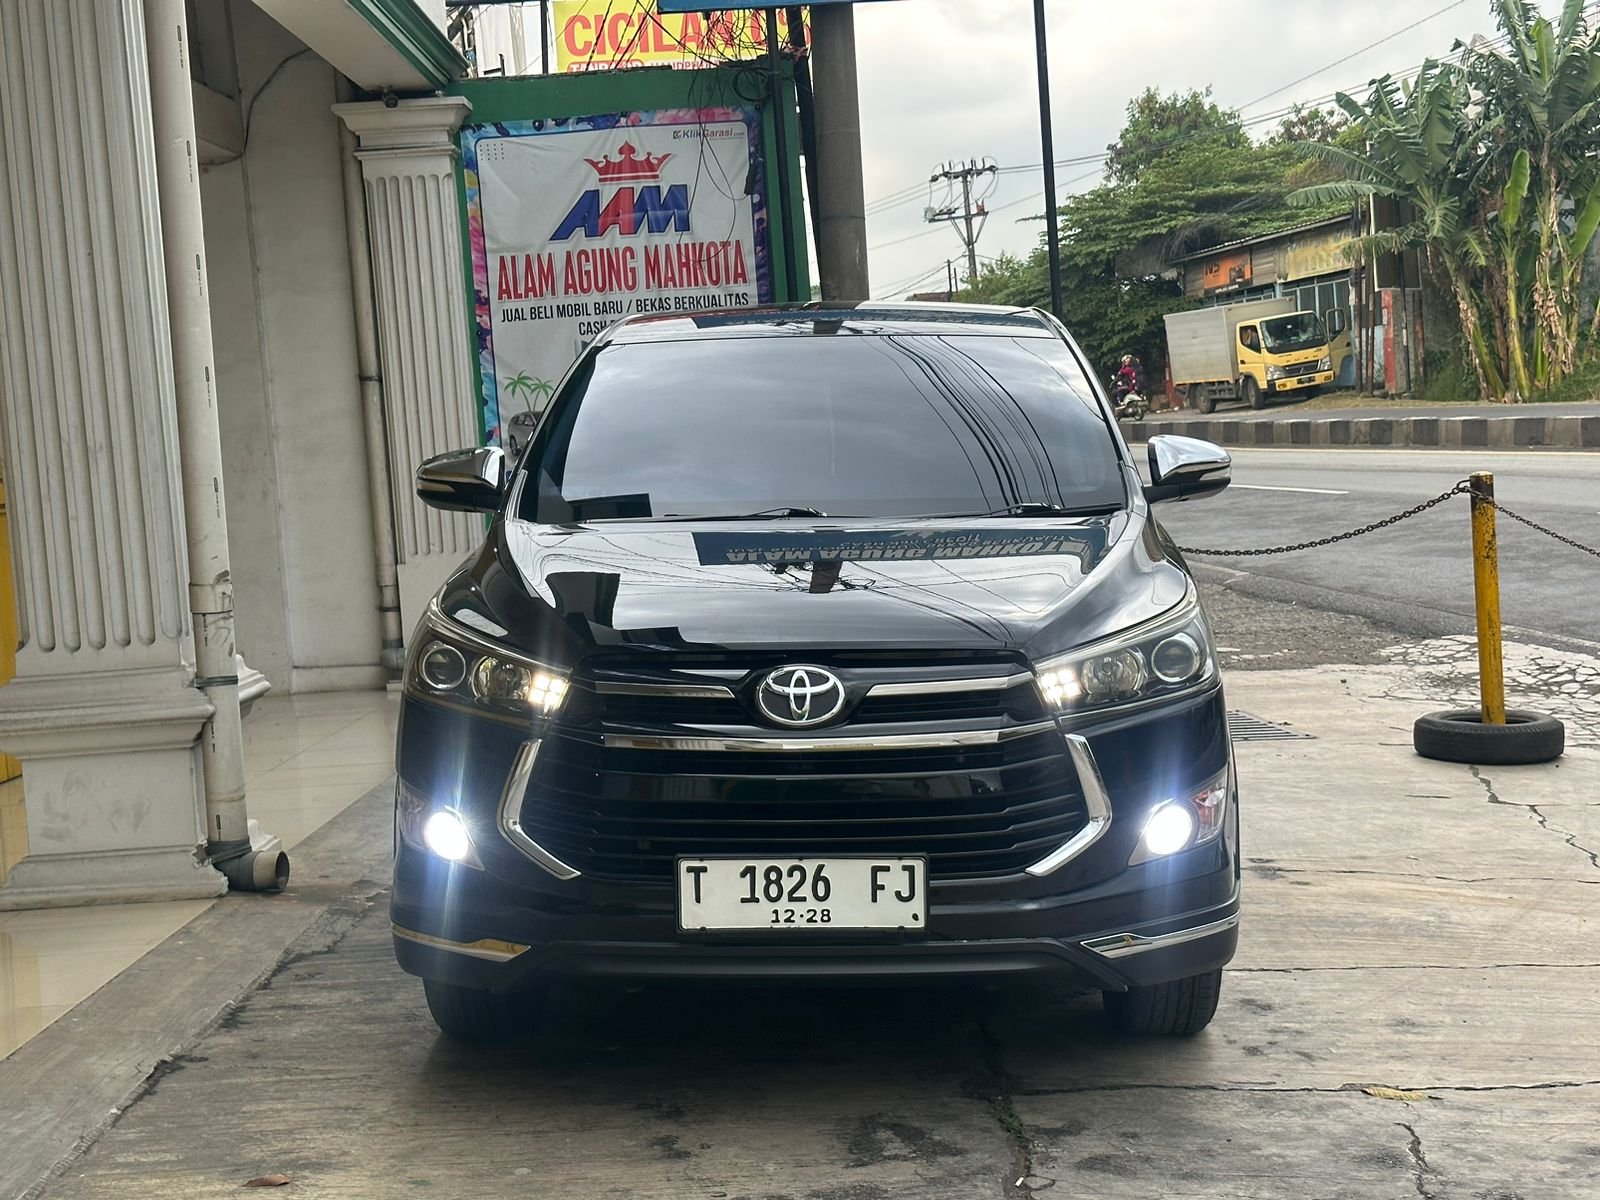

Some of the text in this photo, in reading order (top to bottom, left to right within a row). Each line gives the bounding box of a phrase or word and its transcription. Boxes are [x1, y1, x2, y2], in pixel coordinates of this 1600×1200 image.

[548, 184, 690, 241] AAM
[498, 240, 748, 301] ALAM AGUNG MAHKOTA
[501, 307, 527, 323] JUAL
[530, 305, 554, 320] BELI
[556, 302, 591, 318] MOBIL
[594, 300, 623, 315] BARU
[636, 297, 672, 313] BEKAS
[674, 292, 749, 310] BERKUALITAS
[686, 864, 916, 904] T 1826 FJ
